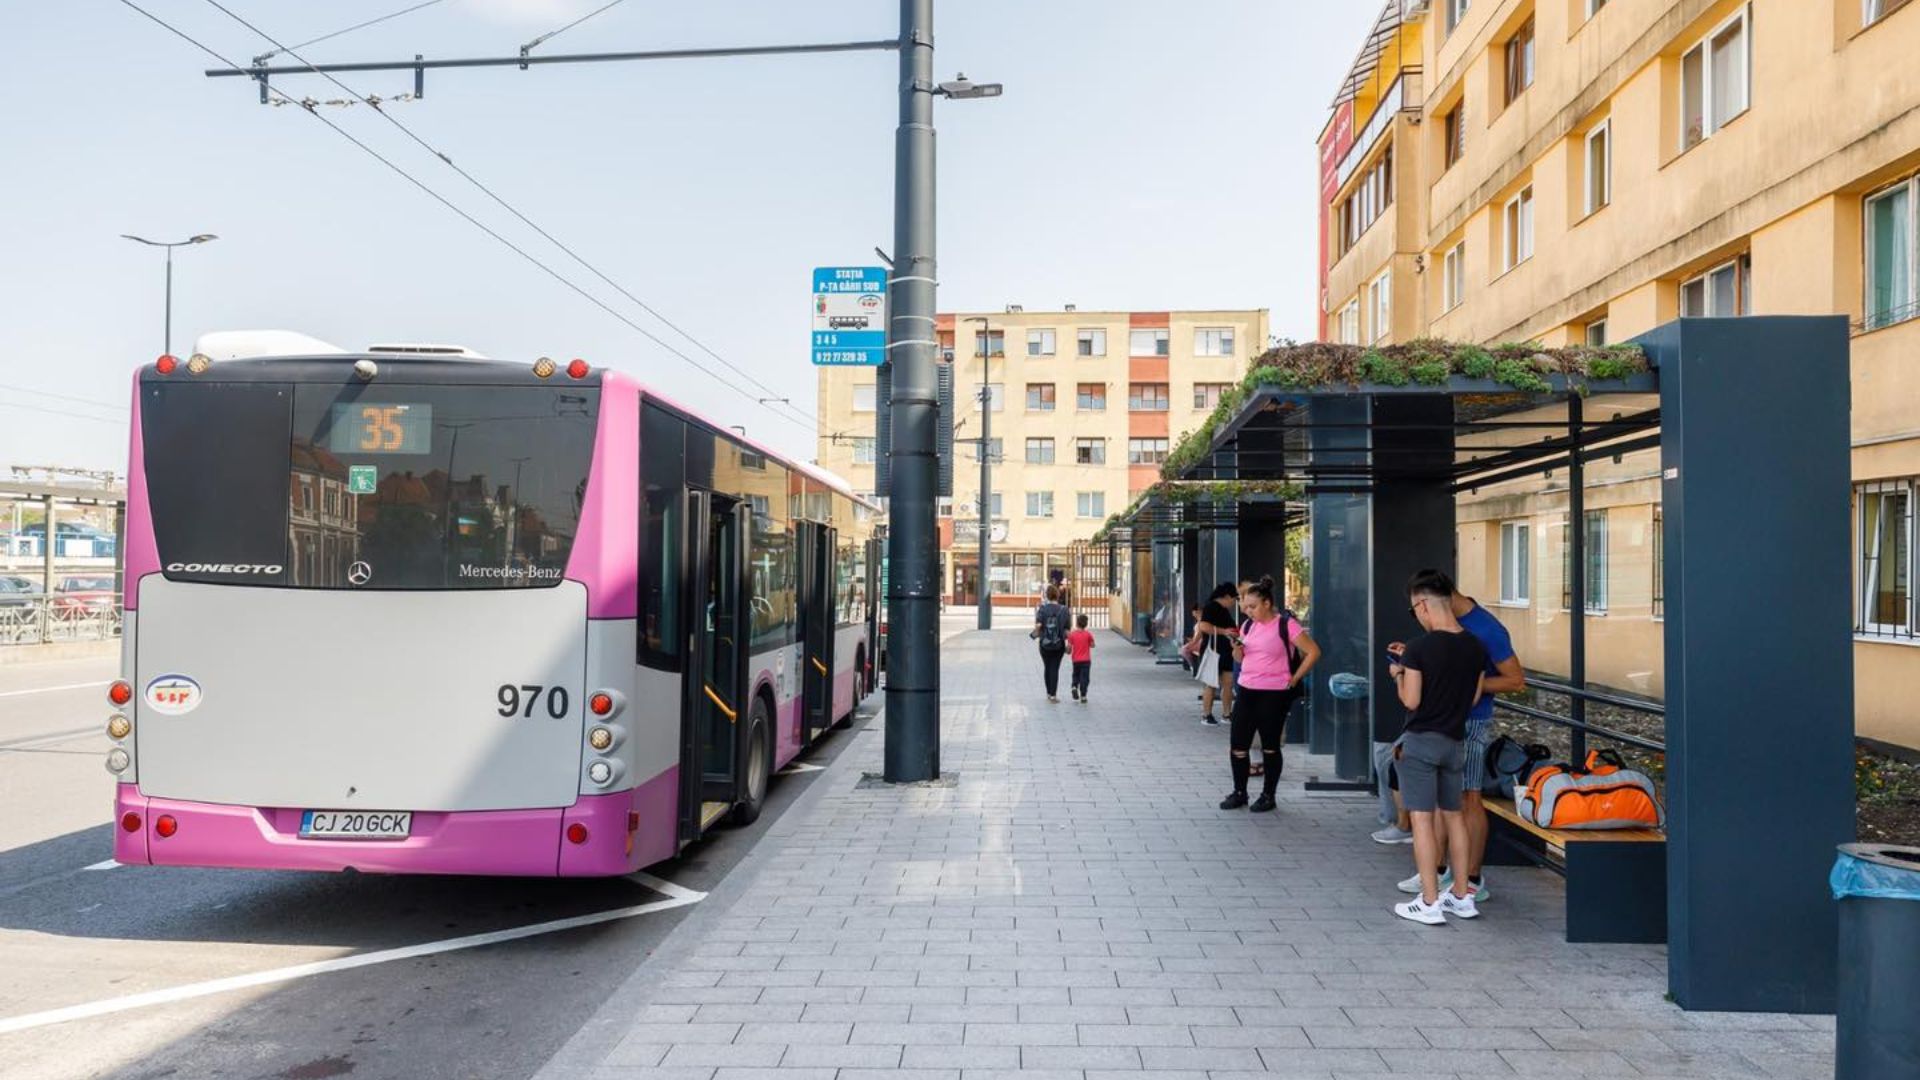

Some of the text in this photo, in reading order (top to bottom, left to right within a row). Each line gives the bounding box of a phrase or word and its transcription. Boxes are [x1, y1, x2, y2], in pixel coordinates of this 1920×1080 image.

[831, 334, 837, 344] 5
[360, 406, 403, 451] 35
[166, 562, 283, 575] CONECTO
[458, 564, 562, 579] Mercedes-Benz
[497, 683, 569, 721] 970
[313, 814, 407, 832] CJ 20 GCK
